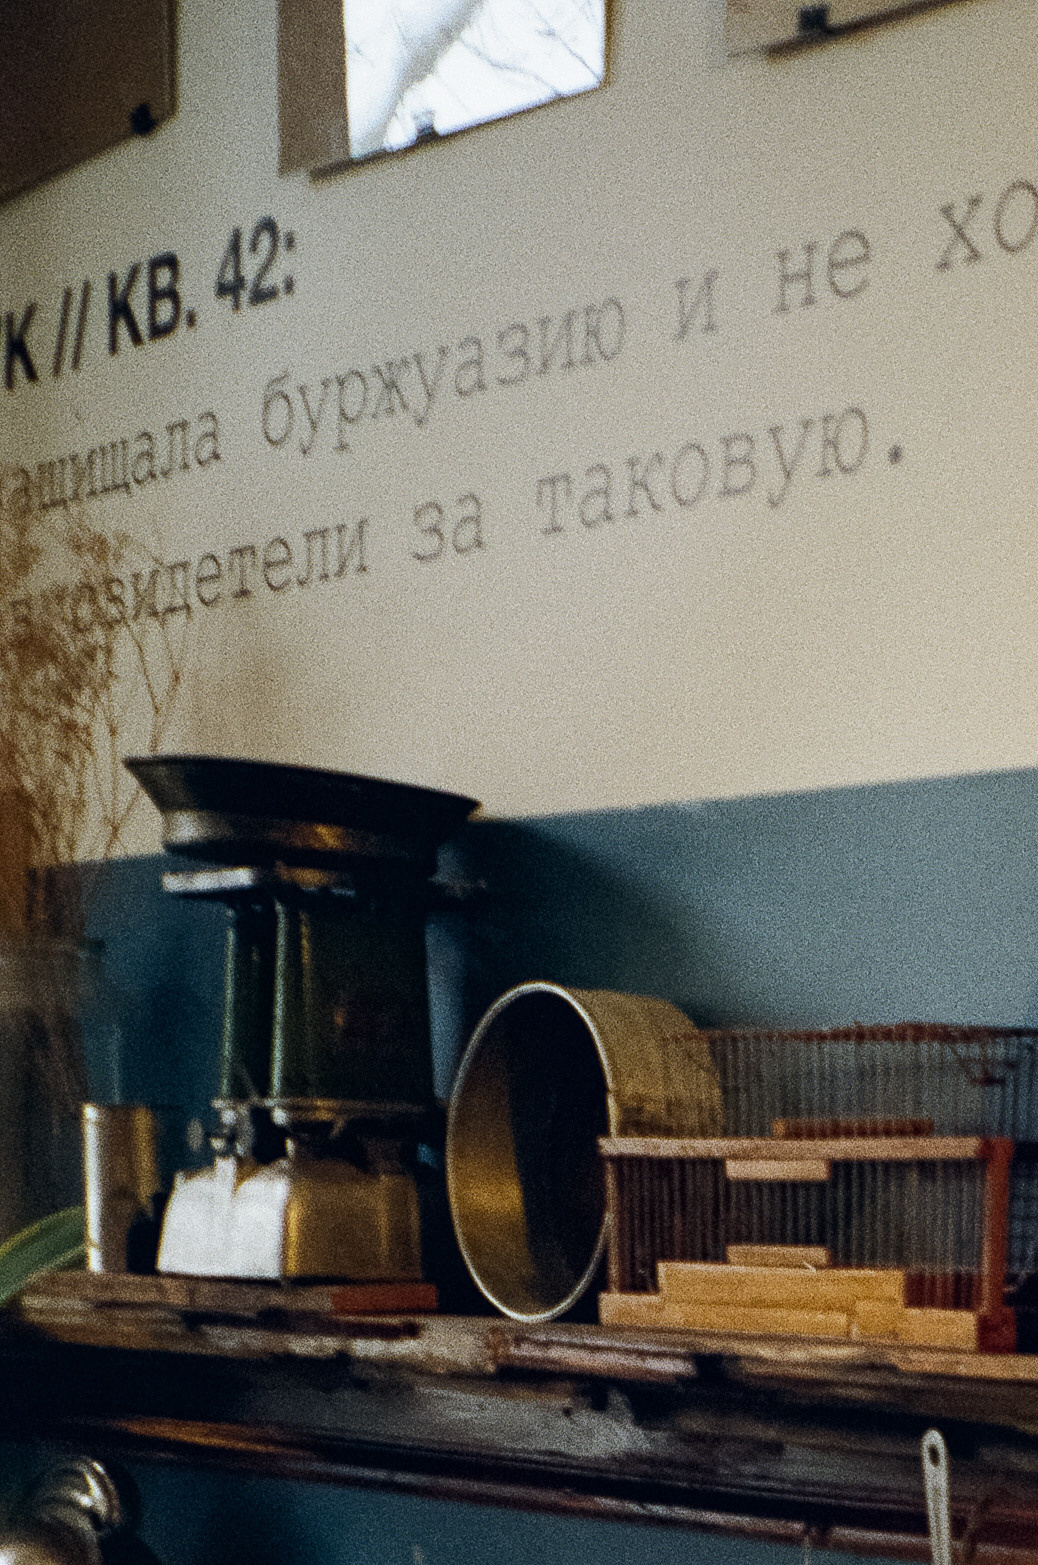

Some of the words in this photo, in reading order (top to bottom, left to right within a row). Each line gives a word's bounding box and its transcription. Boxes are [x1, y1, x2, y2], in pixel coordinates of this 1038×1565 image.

[106, 250, 198, 356] КВ.
[213, 214, 296, 313] 42:
[0, 411, 222, 511] ащищала
[261, 297, 626, 456] буржуазию
[671, 267, 720, 342] и
[771, 228, 871, 315] не
[412, 491, 485, 563] за
[535, 406, 902, 535] таковую.
